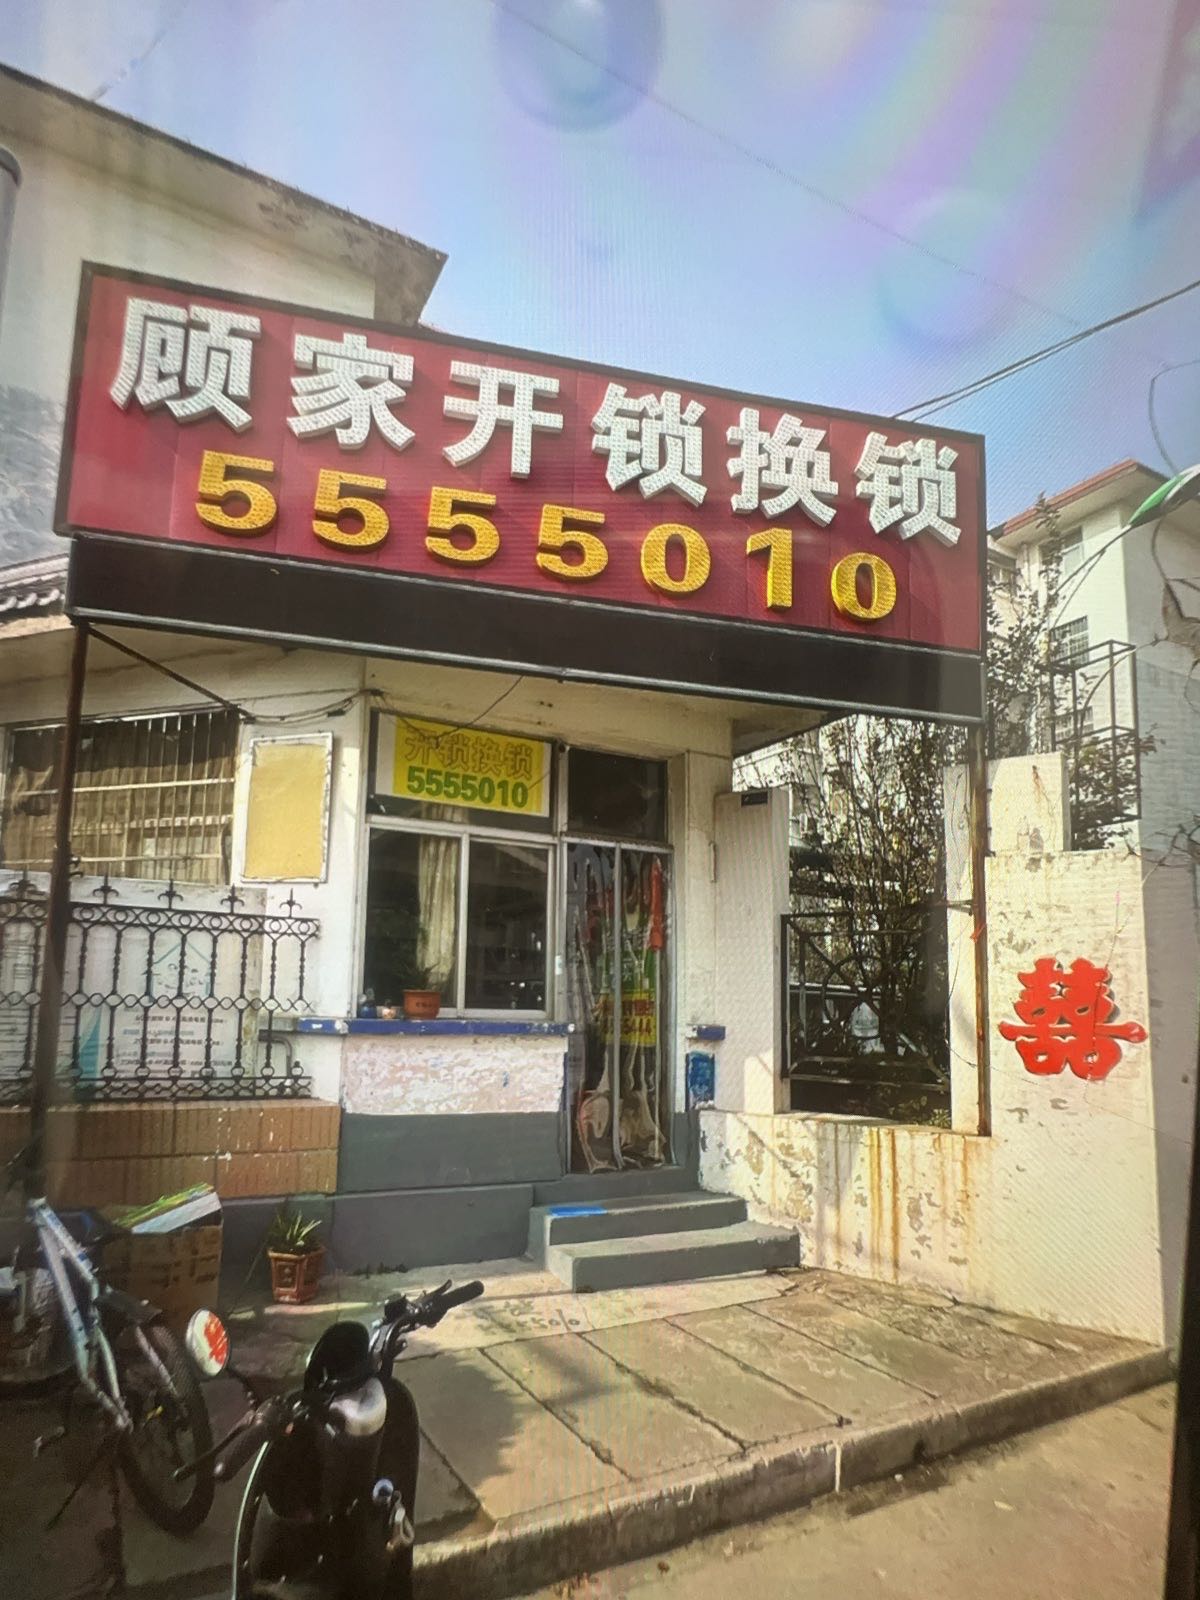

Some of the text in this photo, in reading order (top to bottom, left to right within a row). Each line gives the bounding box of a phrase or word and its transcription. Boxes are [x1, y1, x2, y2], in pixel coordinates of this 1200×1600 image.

[108, 297, 962, 546] 顾家开锁换锁
[195, 450, 897, 621] 5555010
[404, 727, 533, 781] 开锁换锁
[407, 766, 529, 808] 5555010
